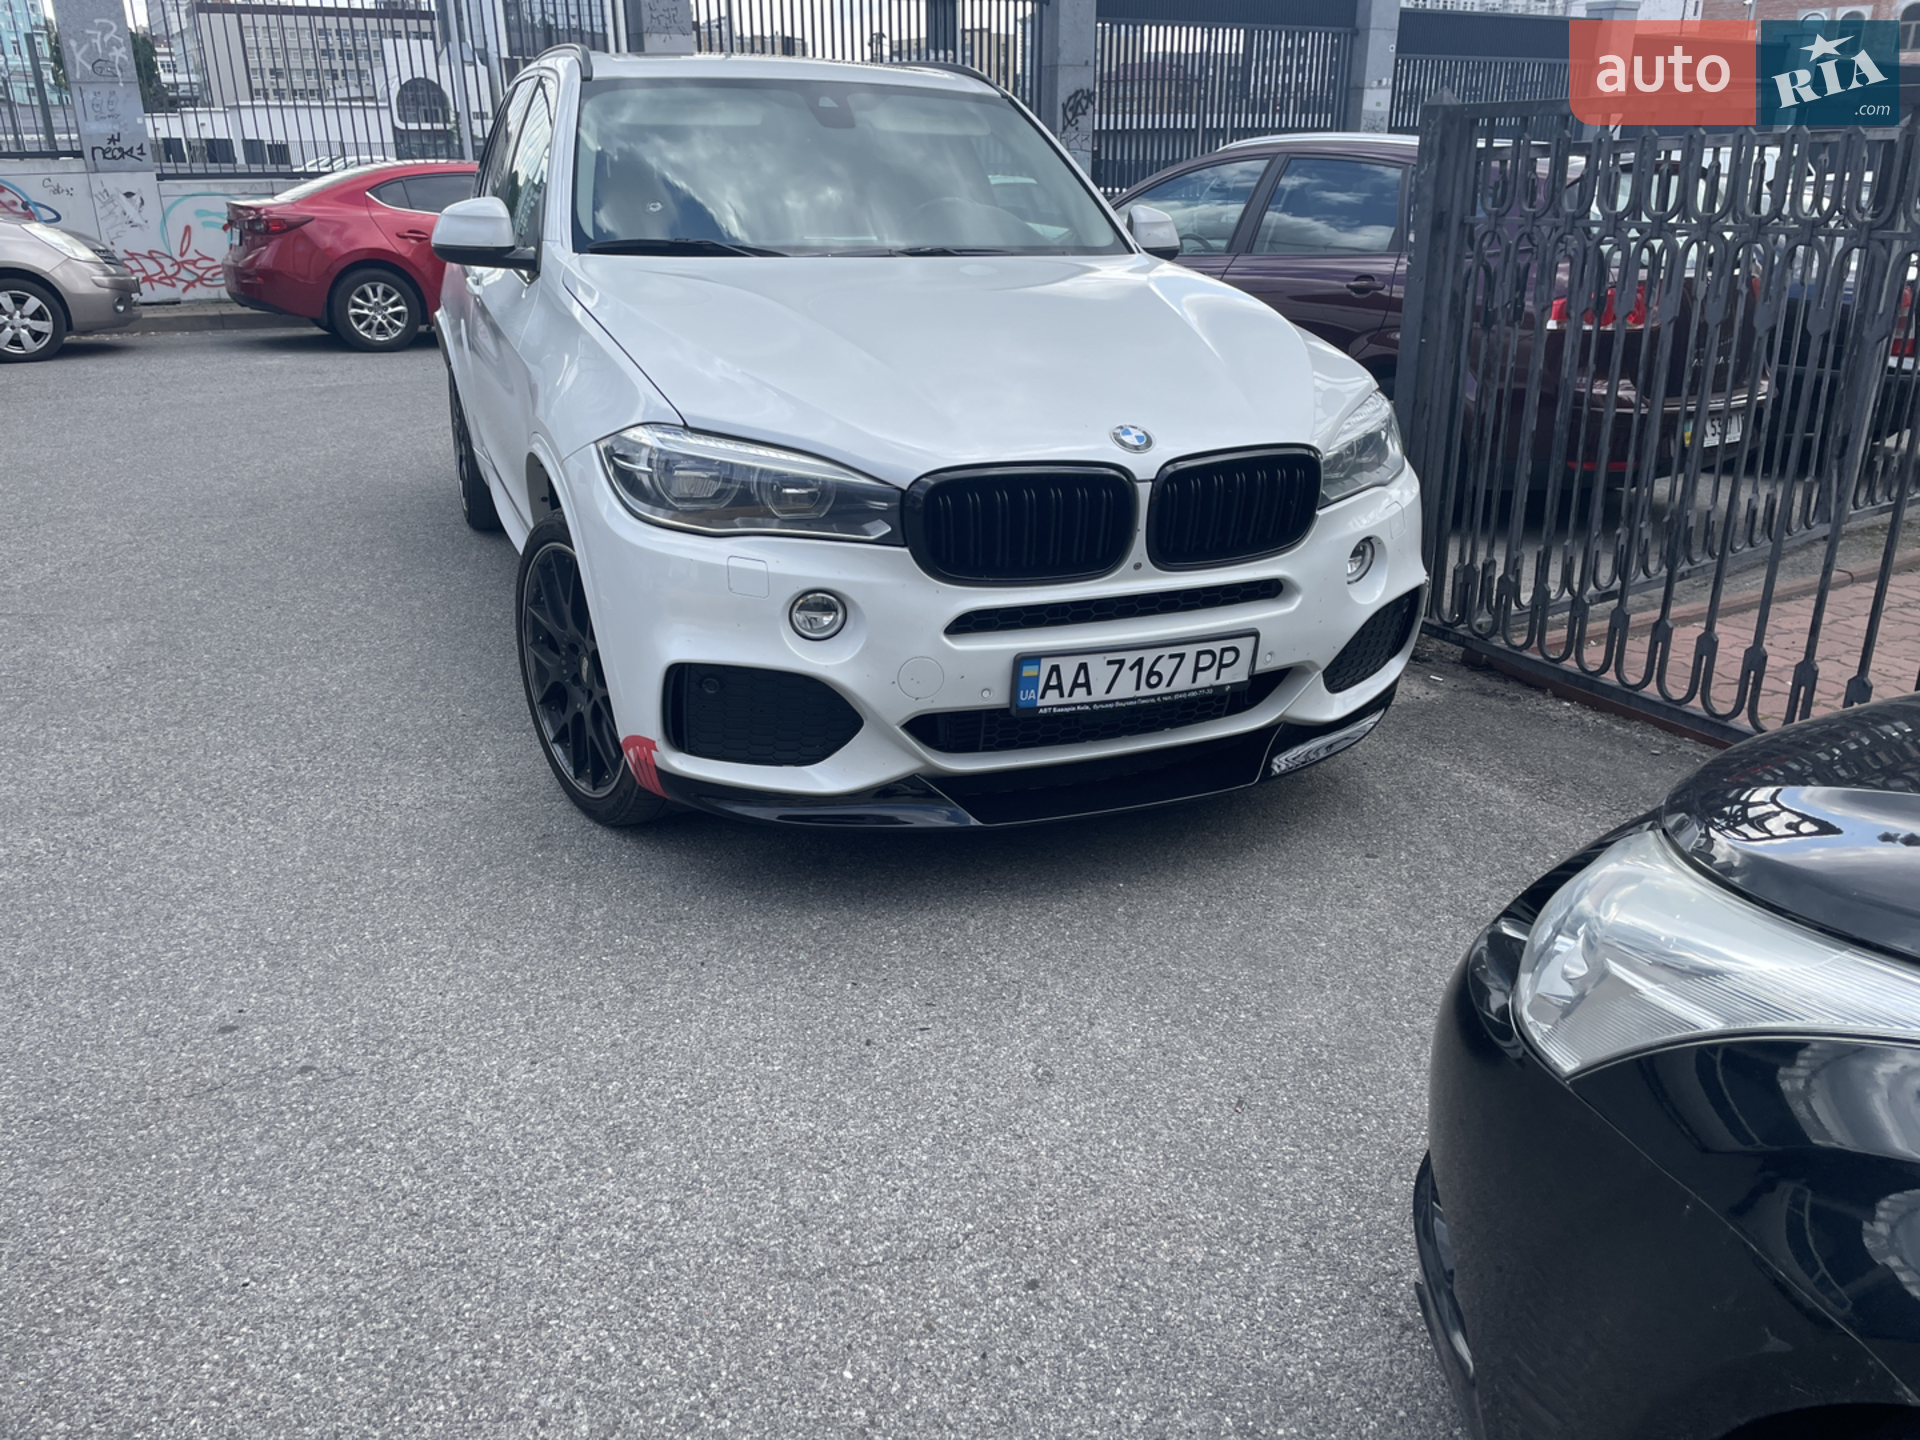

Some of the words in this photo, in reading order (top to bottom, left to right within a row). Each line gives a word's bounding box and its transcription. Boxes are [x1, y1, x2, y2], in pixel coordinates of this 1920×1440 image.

[1039, 662, 1092, 699] AA
[1105, 653, 1186, 695] 7167
[1191, 646, 1240, 684] PP
[1020, 690, 1036, 701] UA
